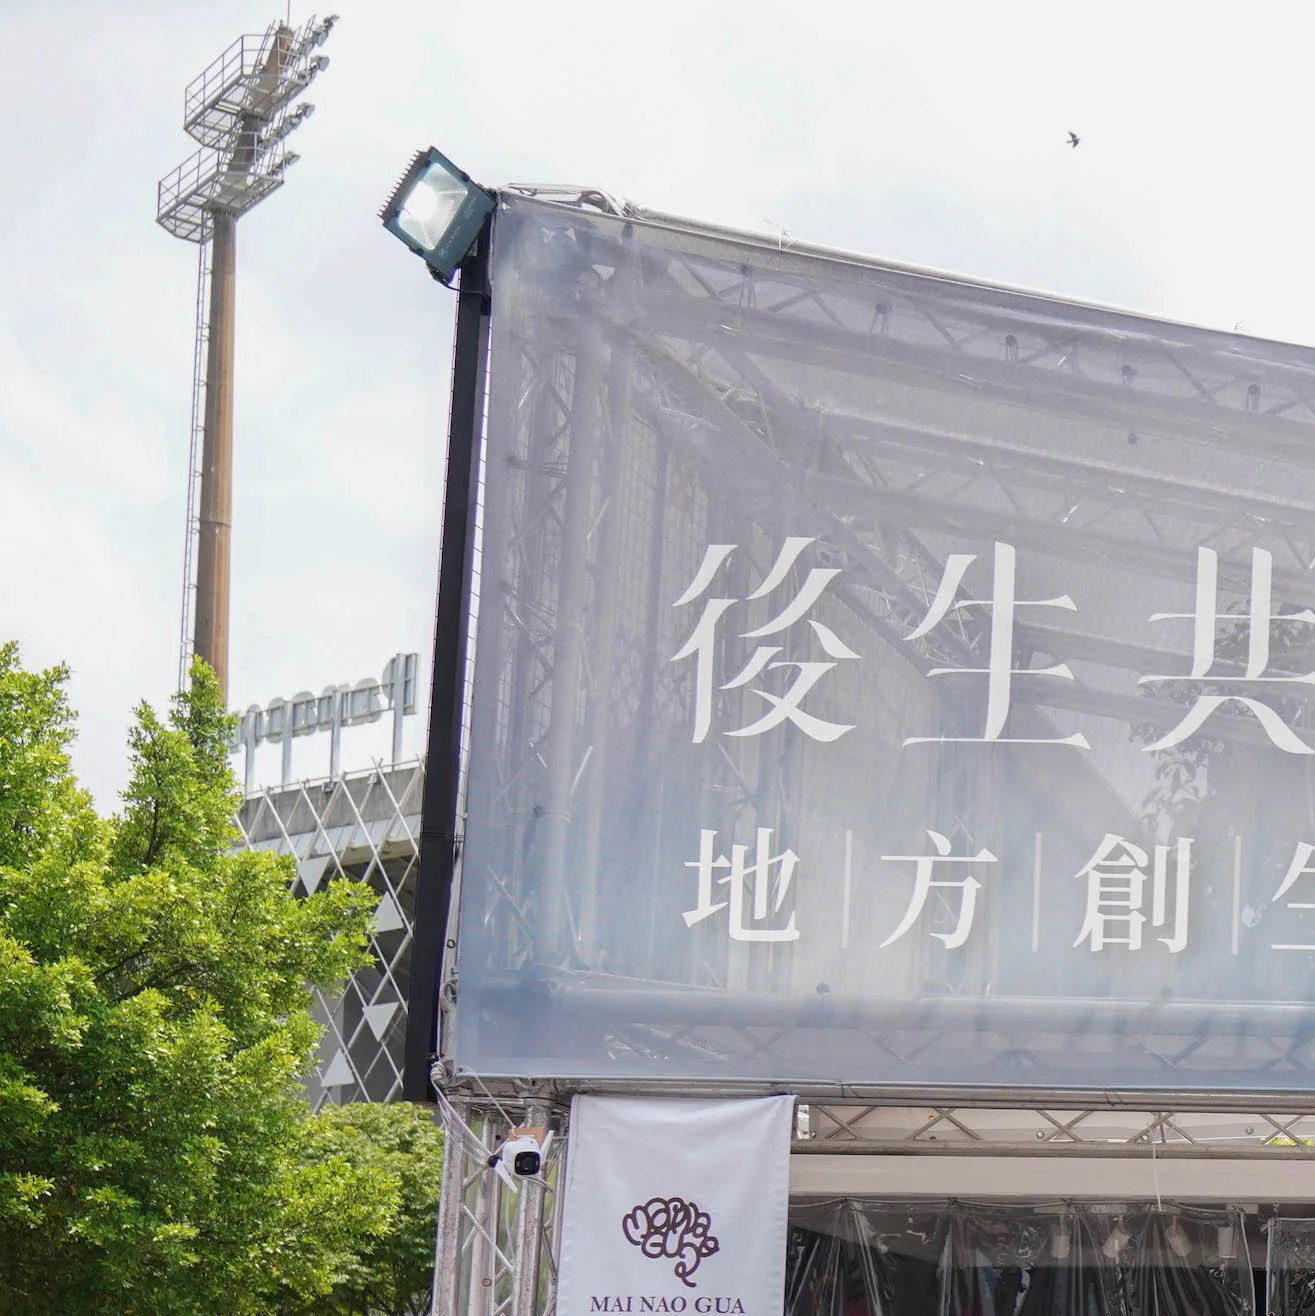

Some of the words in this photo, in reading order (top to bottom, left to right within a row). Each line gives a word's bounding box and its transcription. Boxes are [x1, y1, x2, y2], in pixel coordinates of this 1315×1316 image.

[590, 1296, 633, 1313] MAI
[640, 1296, 687, 1313] NAO
[695, 1296, 745, 1314] GUA
